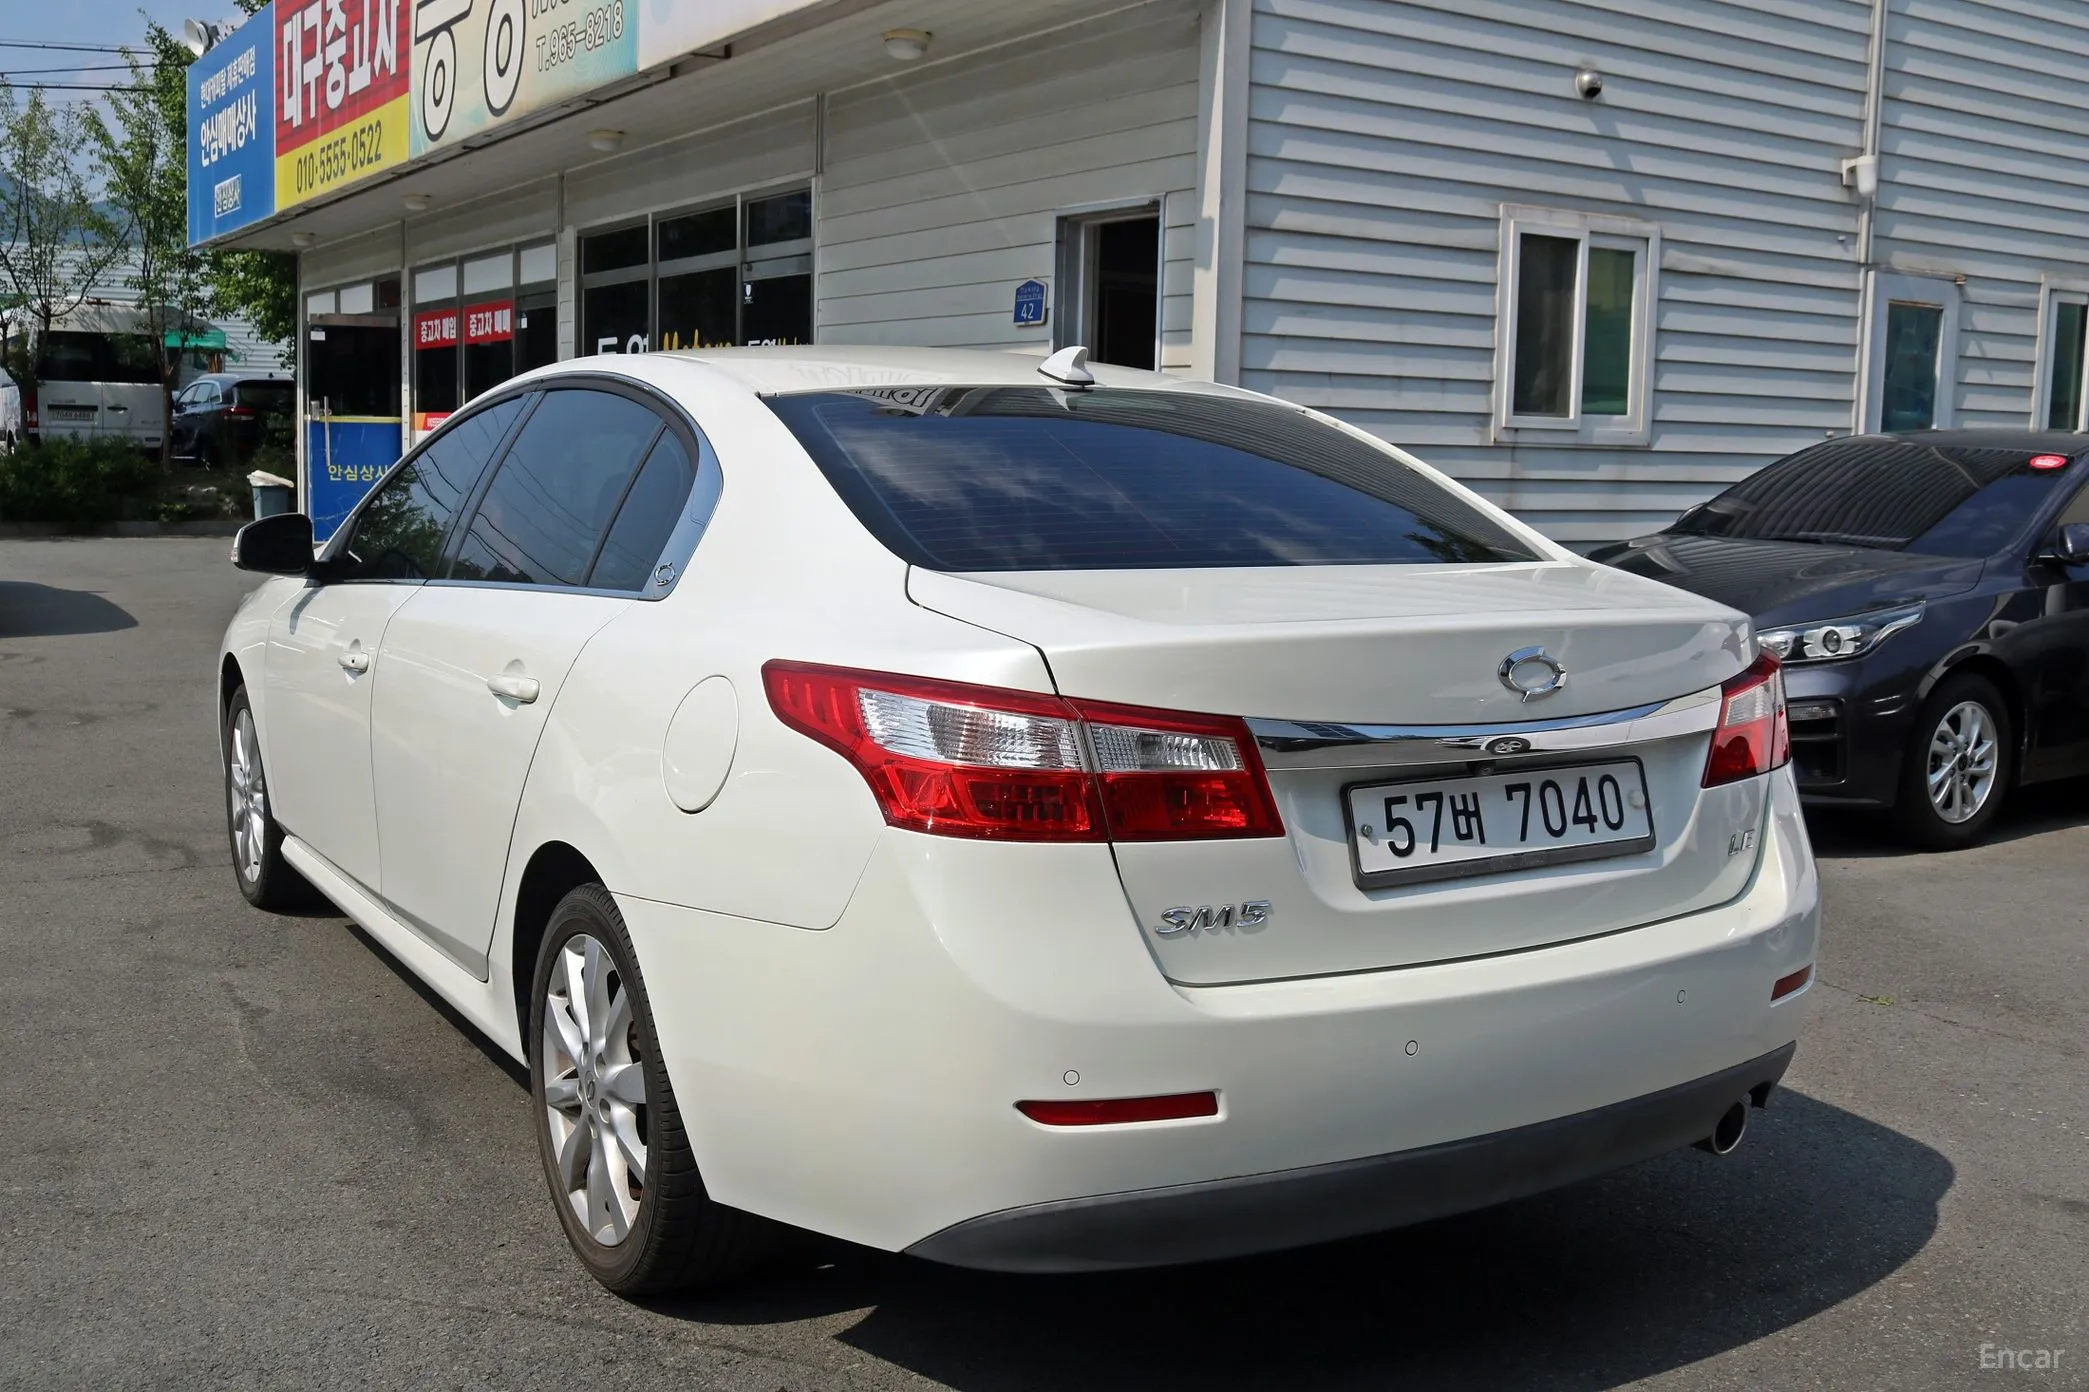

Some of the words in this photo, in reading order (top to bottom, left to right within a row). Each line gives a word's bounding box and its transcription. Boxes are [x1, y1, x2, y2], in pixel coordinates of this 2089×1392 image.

[536, 0, 623, 72] T.965-8218
[201, 89, 257, 167] 안심매매상사
[470, 311, 492, 337] 중고차
[1021, 303, 1034, 319] 42
[421, 319, 441, 343] 중고차
[1383, 791, 1486, 858] 57버
[1505, 773, 1625, 842] 7040
[1155, 900, 1272, 934] SM5
